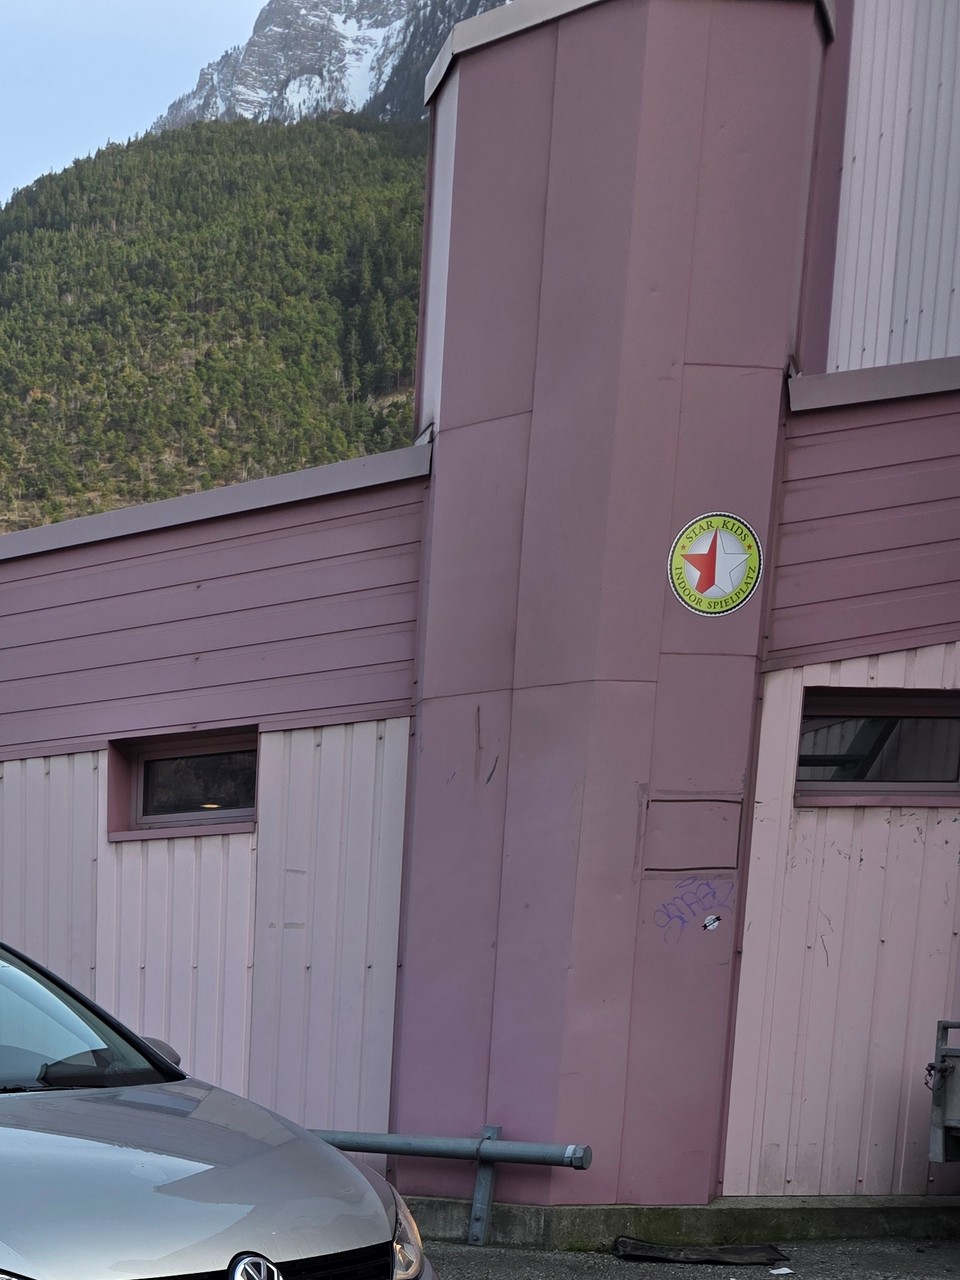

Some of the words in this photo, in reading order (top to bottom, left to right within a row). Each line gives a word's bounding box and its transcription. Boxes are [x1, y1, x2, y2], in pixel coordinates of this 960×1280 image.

[685, 520, 714, 543] STAR
[721, 519, 750, 543] KIDS
[674, 566, 703, 608] INDOOR
[706, 565, 757, 609] SPIELPLATZ
